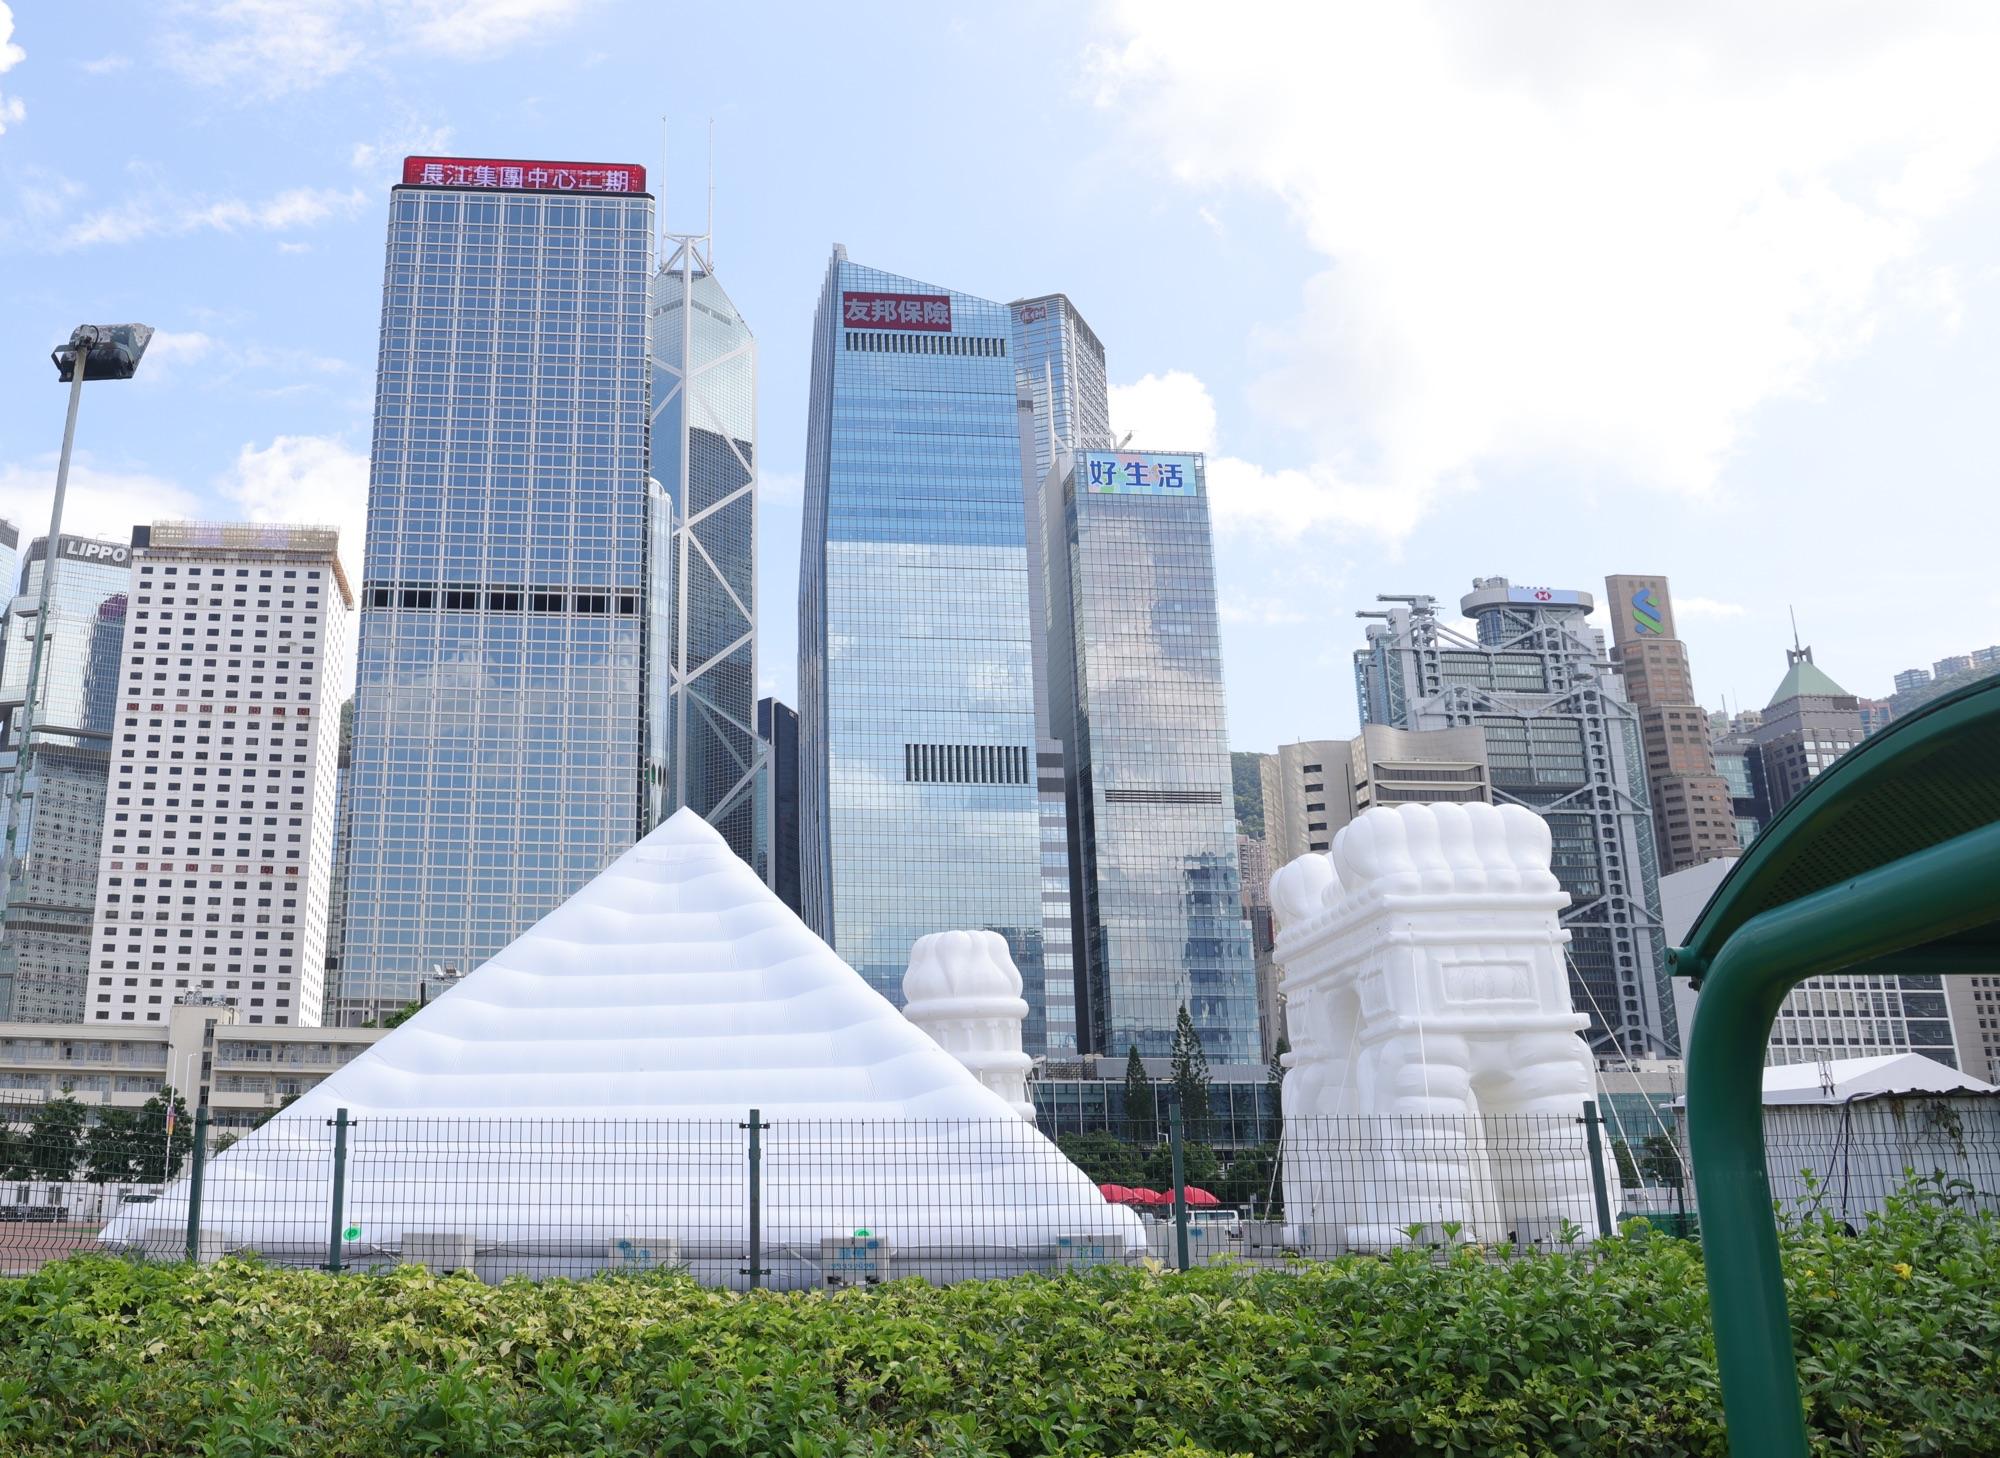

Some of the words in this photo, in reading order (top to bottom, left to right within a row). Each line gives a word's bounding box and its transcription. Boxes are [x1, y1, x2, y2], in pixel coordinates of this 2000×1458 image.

[420, 163, 629, 193] 長江集團中心二期
[844, 298, 950, 326] 友邦保險
[1089, 460, 1184, 488] 好生活
[66, 540, 128, 562] LIPPO
